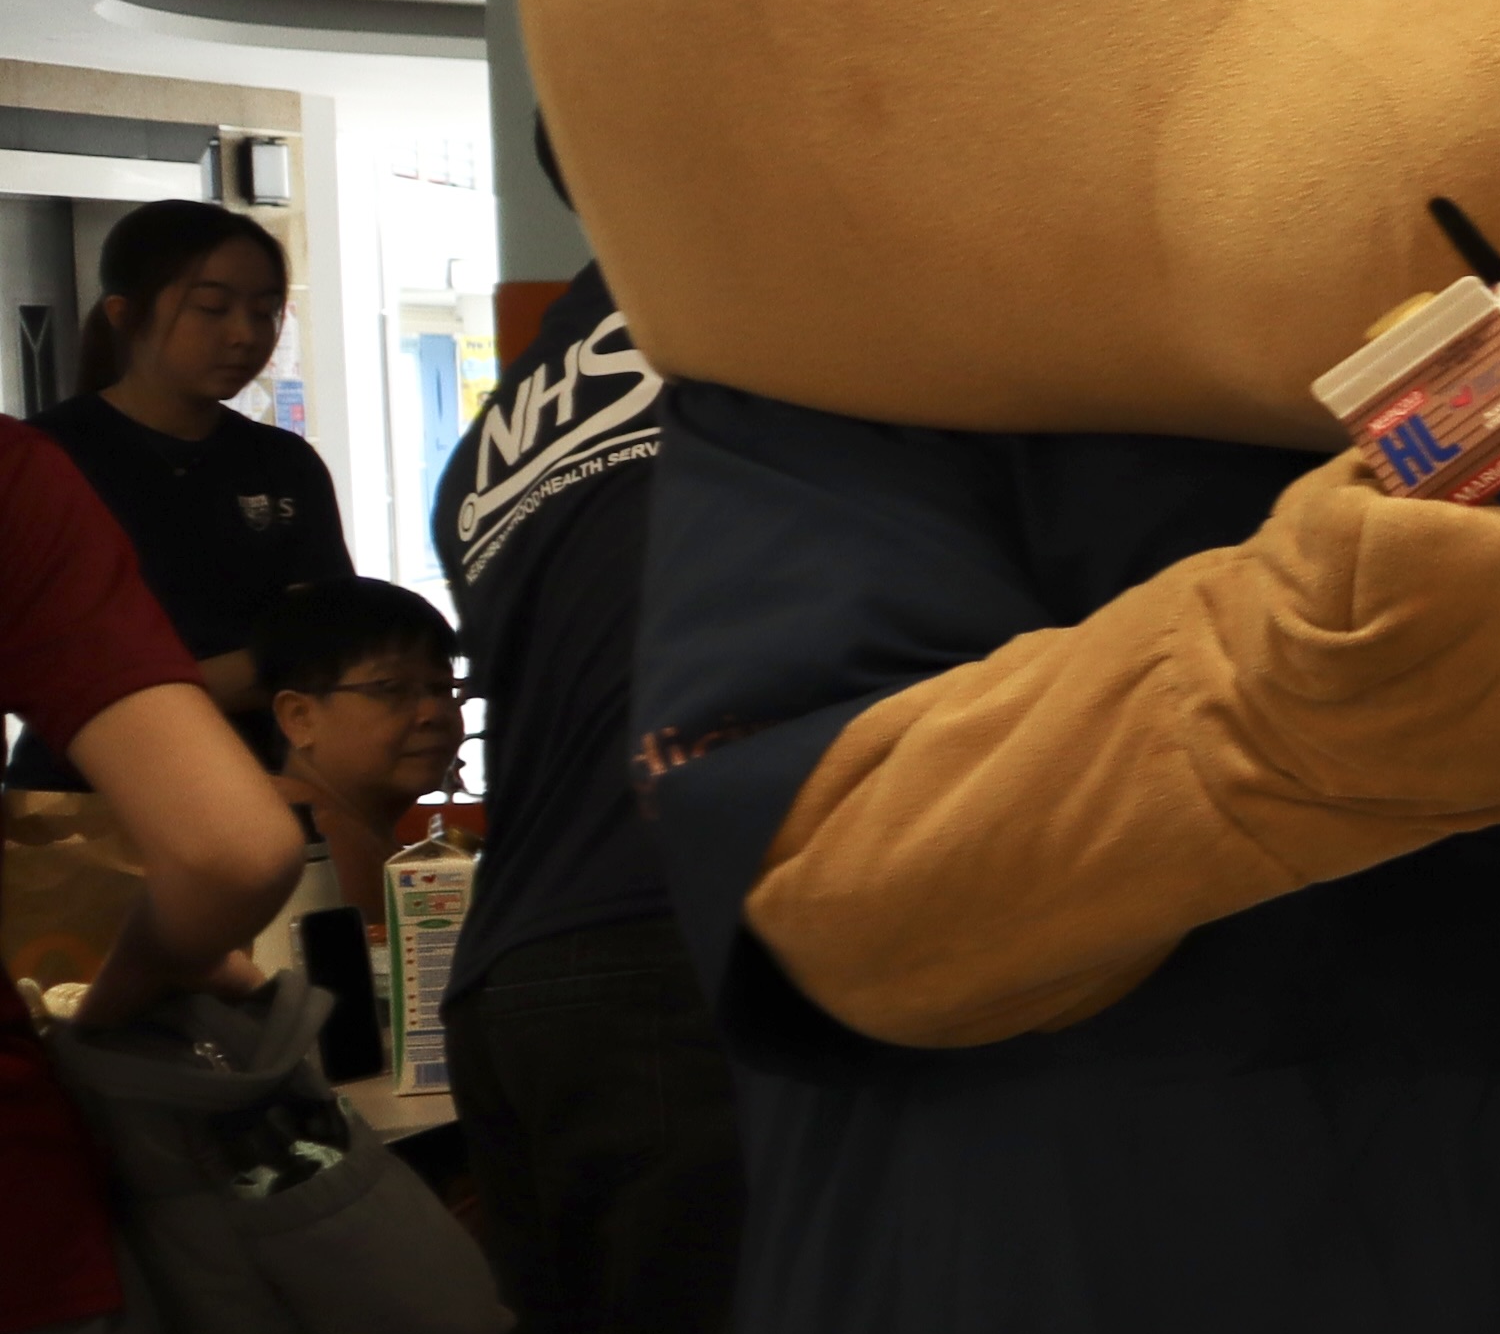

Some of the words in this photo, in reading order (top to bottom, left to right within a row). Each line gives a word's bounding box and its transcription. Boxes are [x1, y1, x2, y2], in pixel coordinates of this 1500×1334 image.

[468, 311, 664, 503] NHS
[540, 456, 603, 497] HEALTH
[1379, 414, 1463, 488] HL
